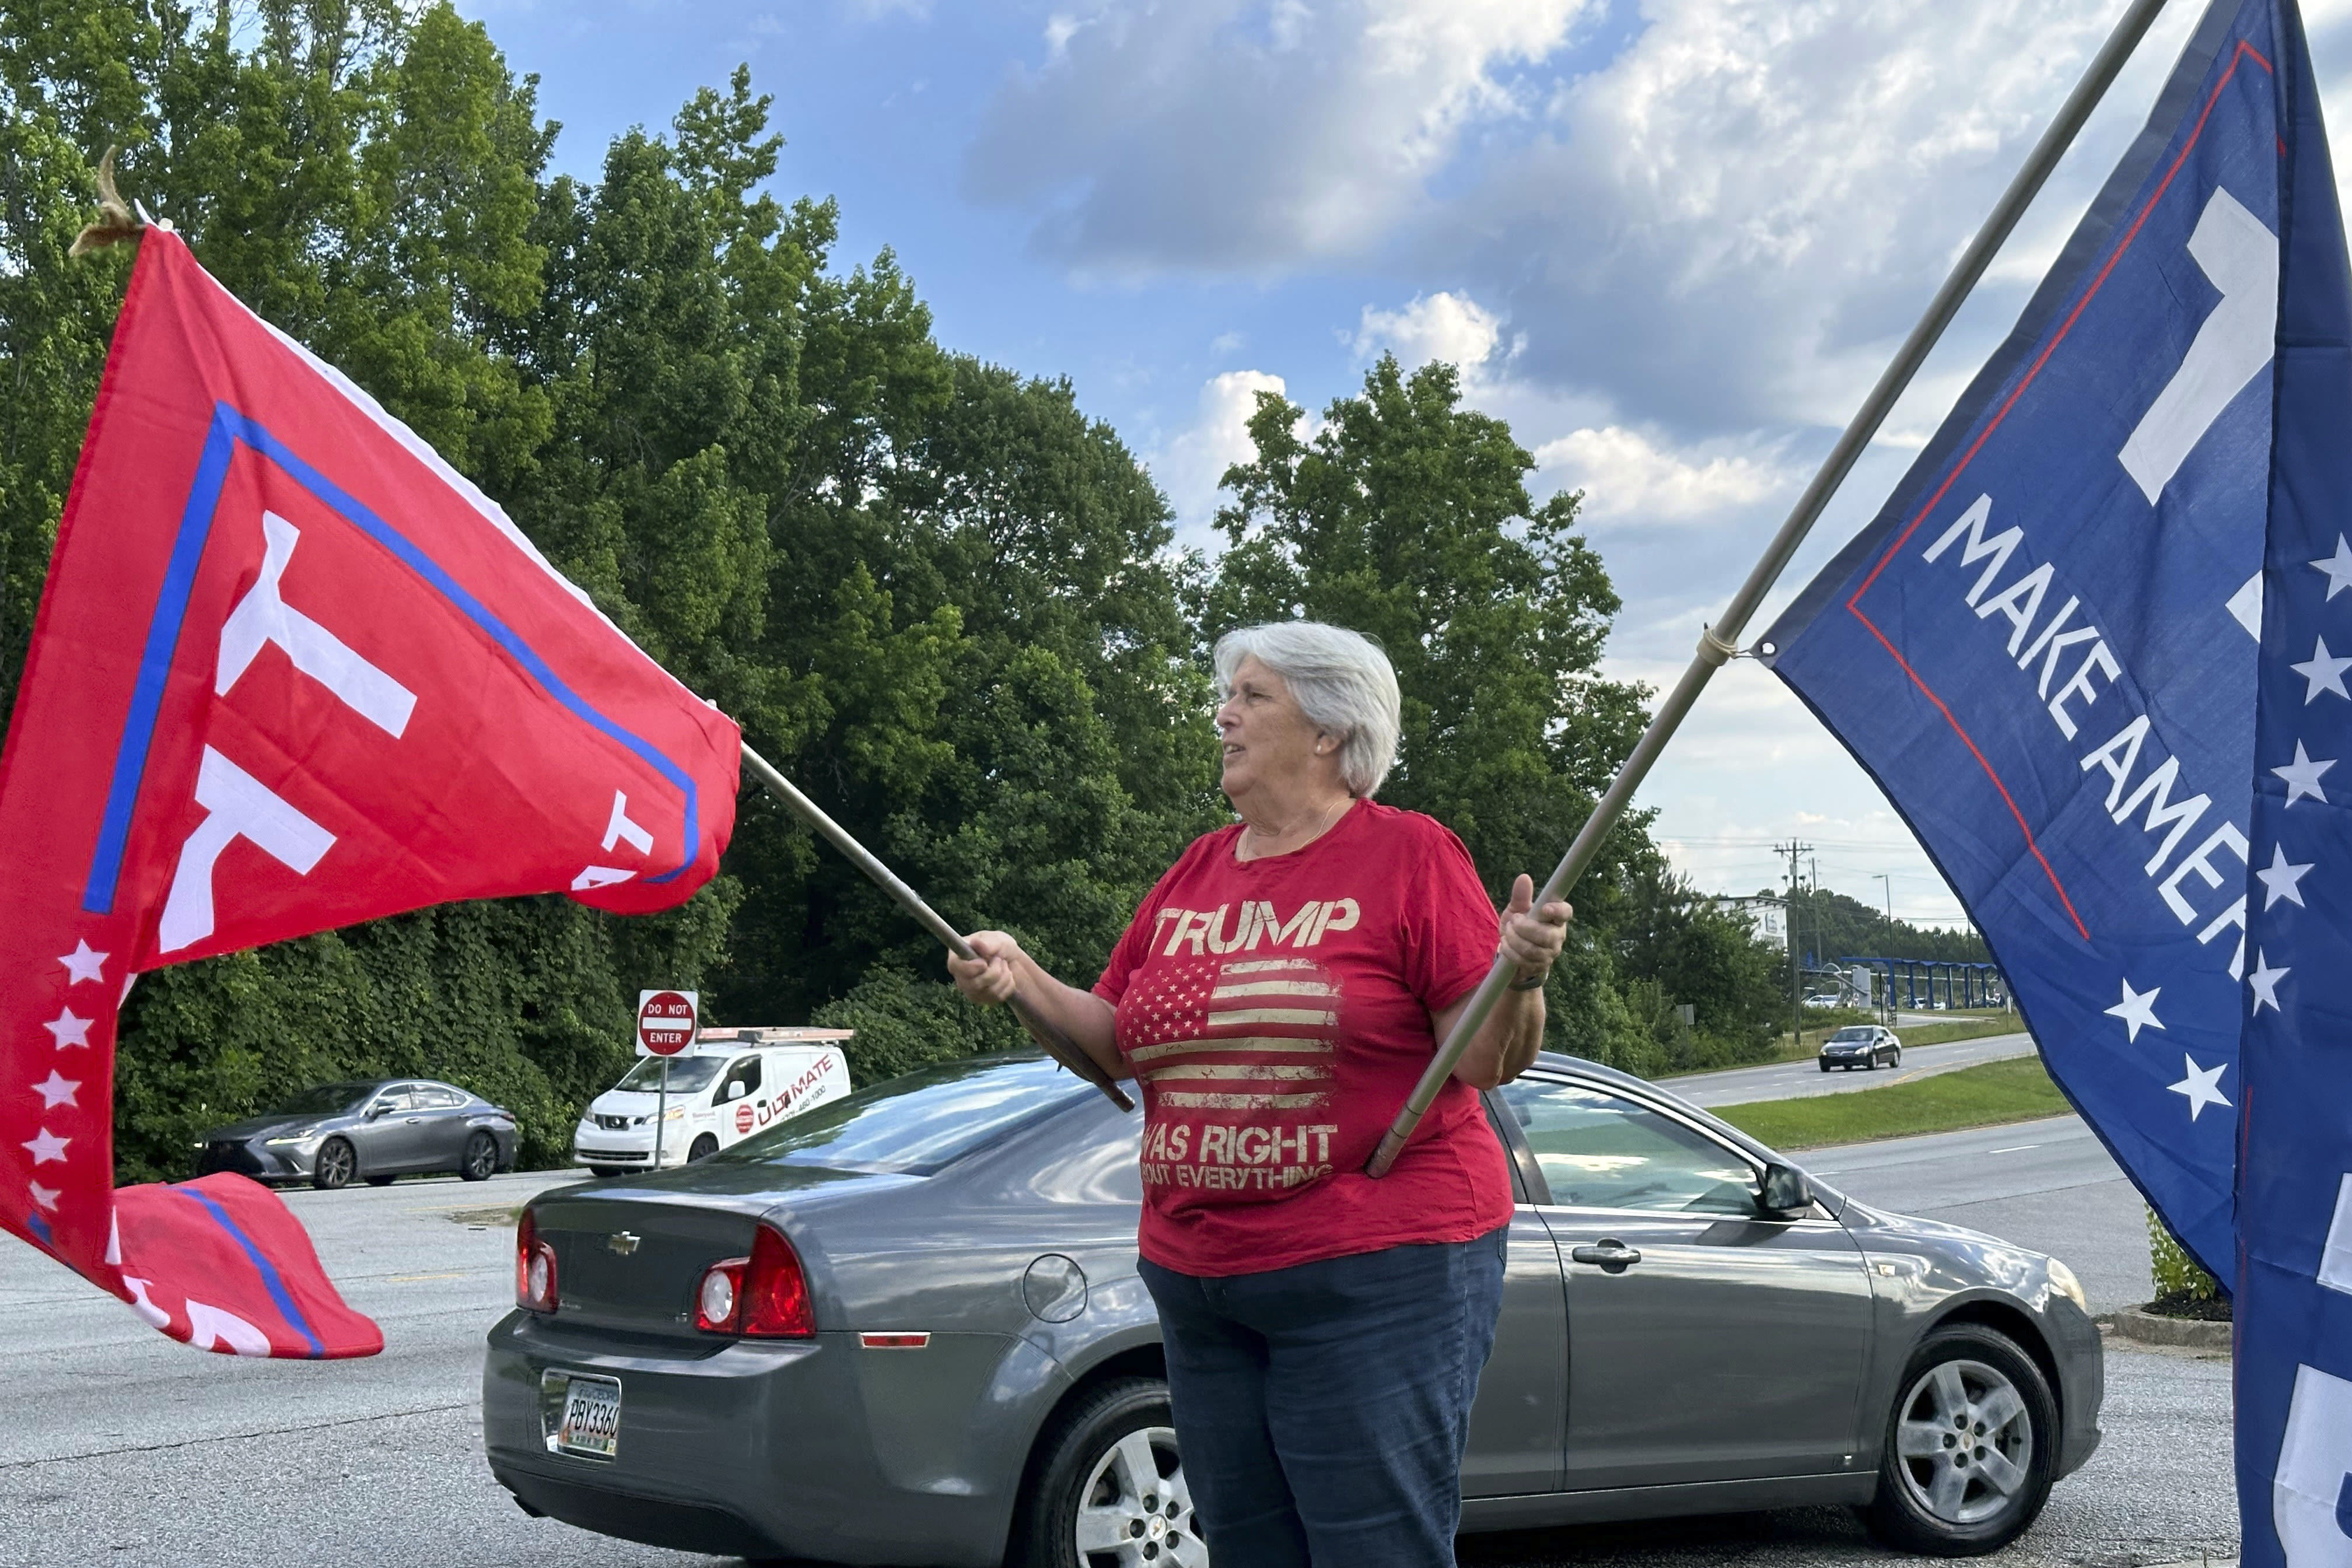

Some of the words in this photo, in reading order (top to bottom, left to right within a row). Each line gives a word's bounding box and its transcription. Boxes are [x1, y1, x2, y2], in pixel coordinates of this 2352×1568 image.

[1922, 492, 2122, 741] MAKE
[1147, 897, 1360, 960] TRUMP
[648, 1003, 662, 1014] DO
[668, 1004, 688, 1015] NOT
[649, 1032, 682, 1043] ENTER
[1199, 1124, 1338, 1164] RIGHT
